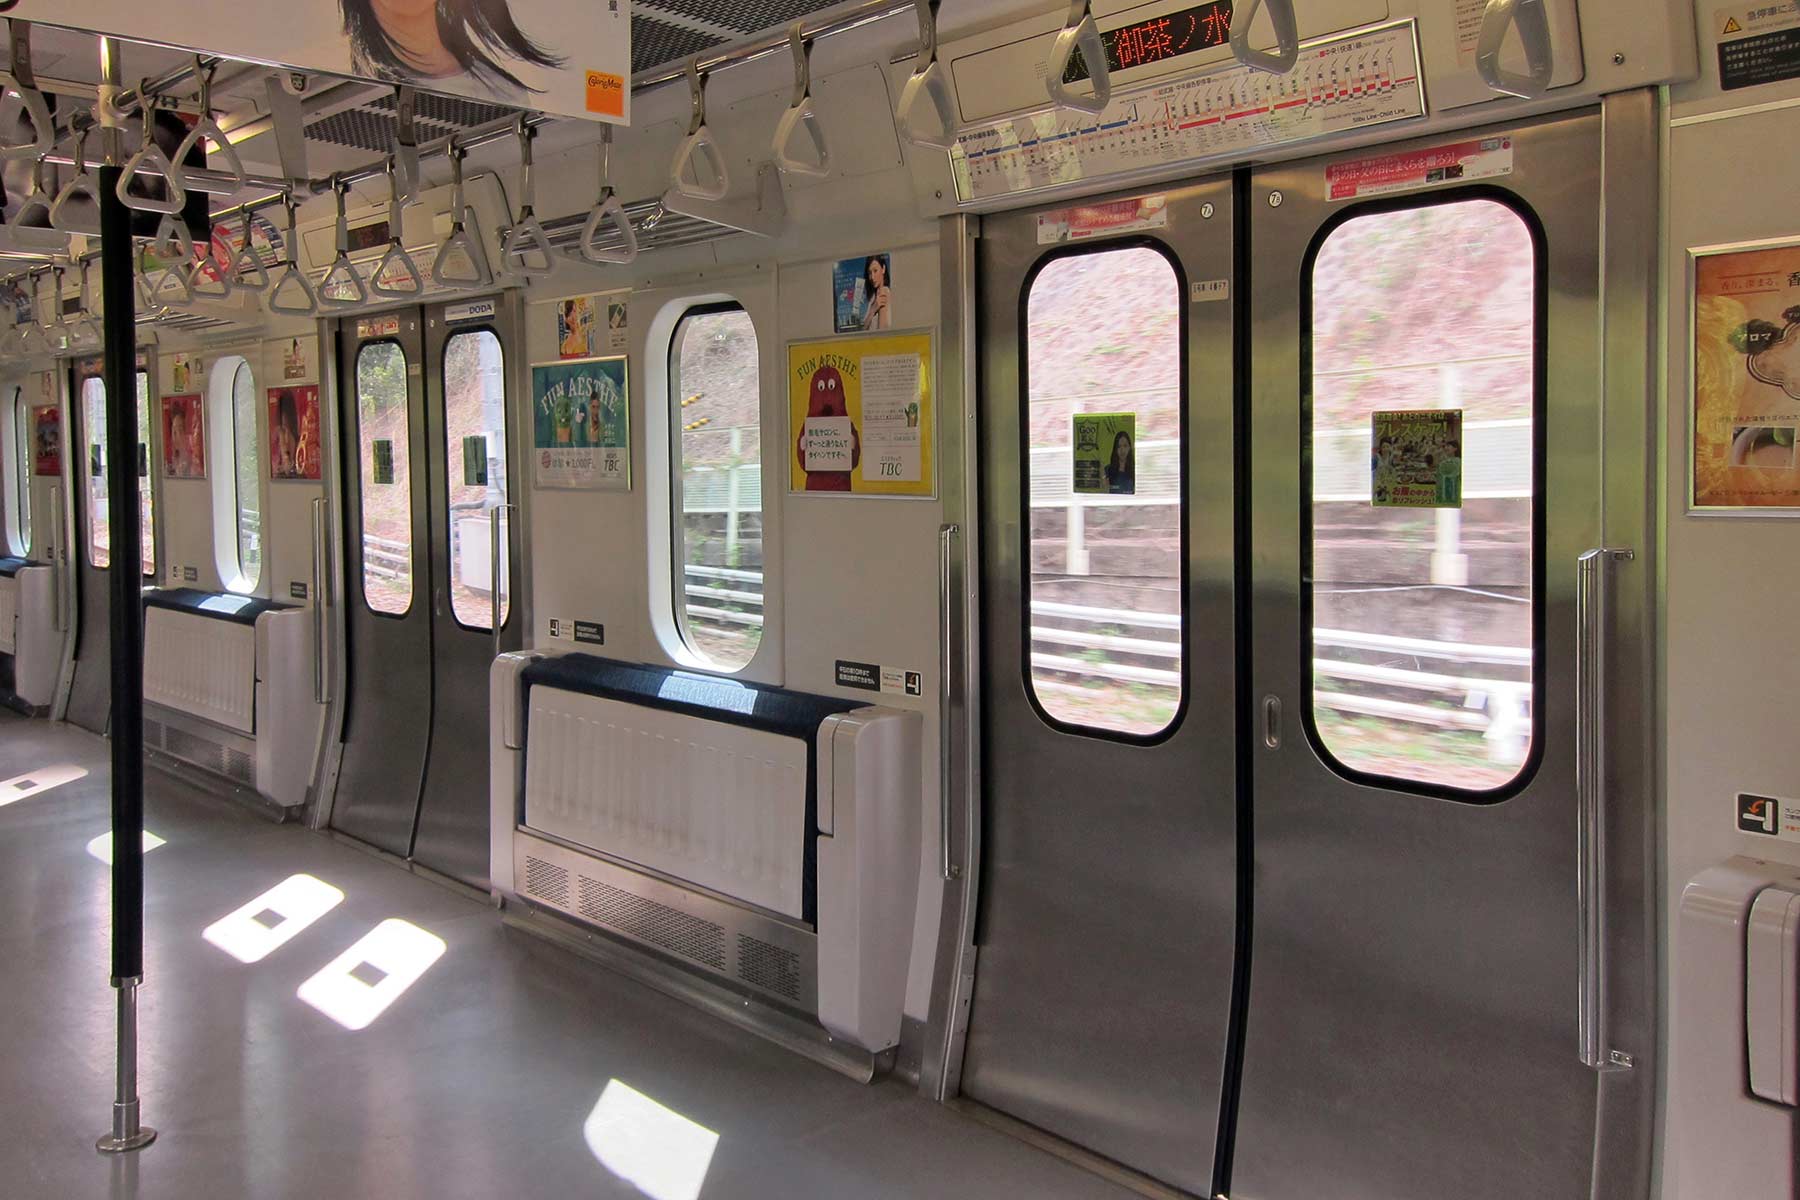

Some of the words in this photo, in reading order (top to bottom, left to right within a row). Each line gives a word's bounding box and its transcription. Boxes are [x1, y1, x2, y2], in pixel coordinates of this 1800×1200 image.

[1114, 5, 1230, 69] 御茶ノ水
[468, 304, 493, 315] DODA
[797, 357, 817, 380] FUN
[540, 381, 565, 415] FUN
[603, 459, 621, 472] TBC
[879, 462, 903, 477] TBC
